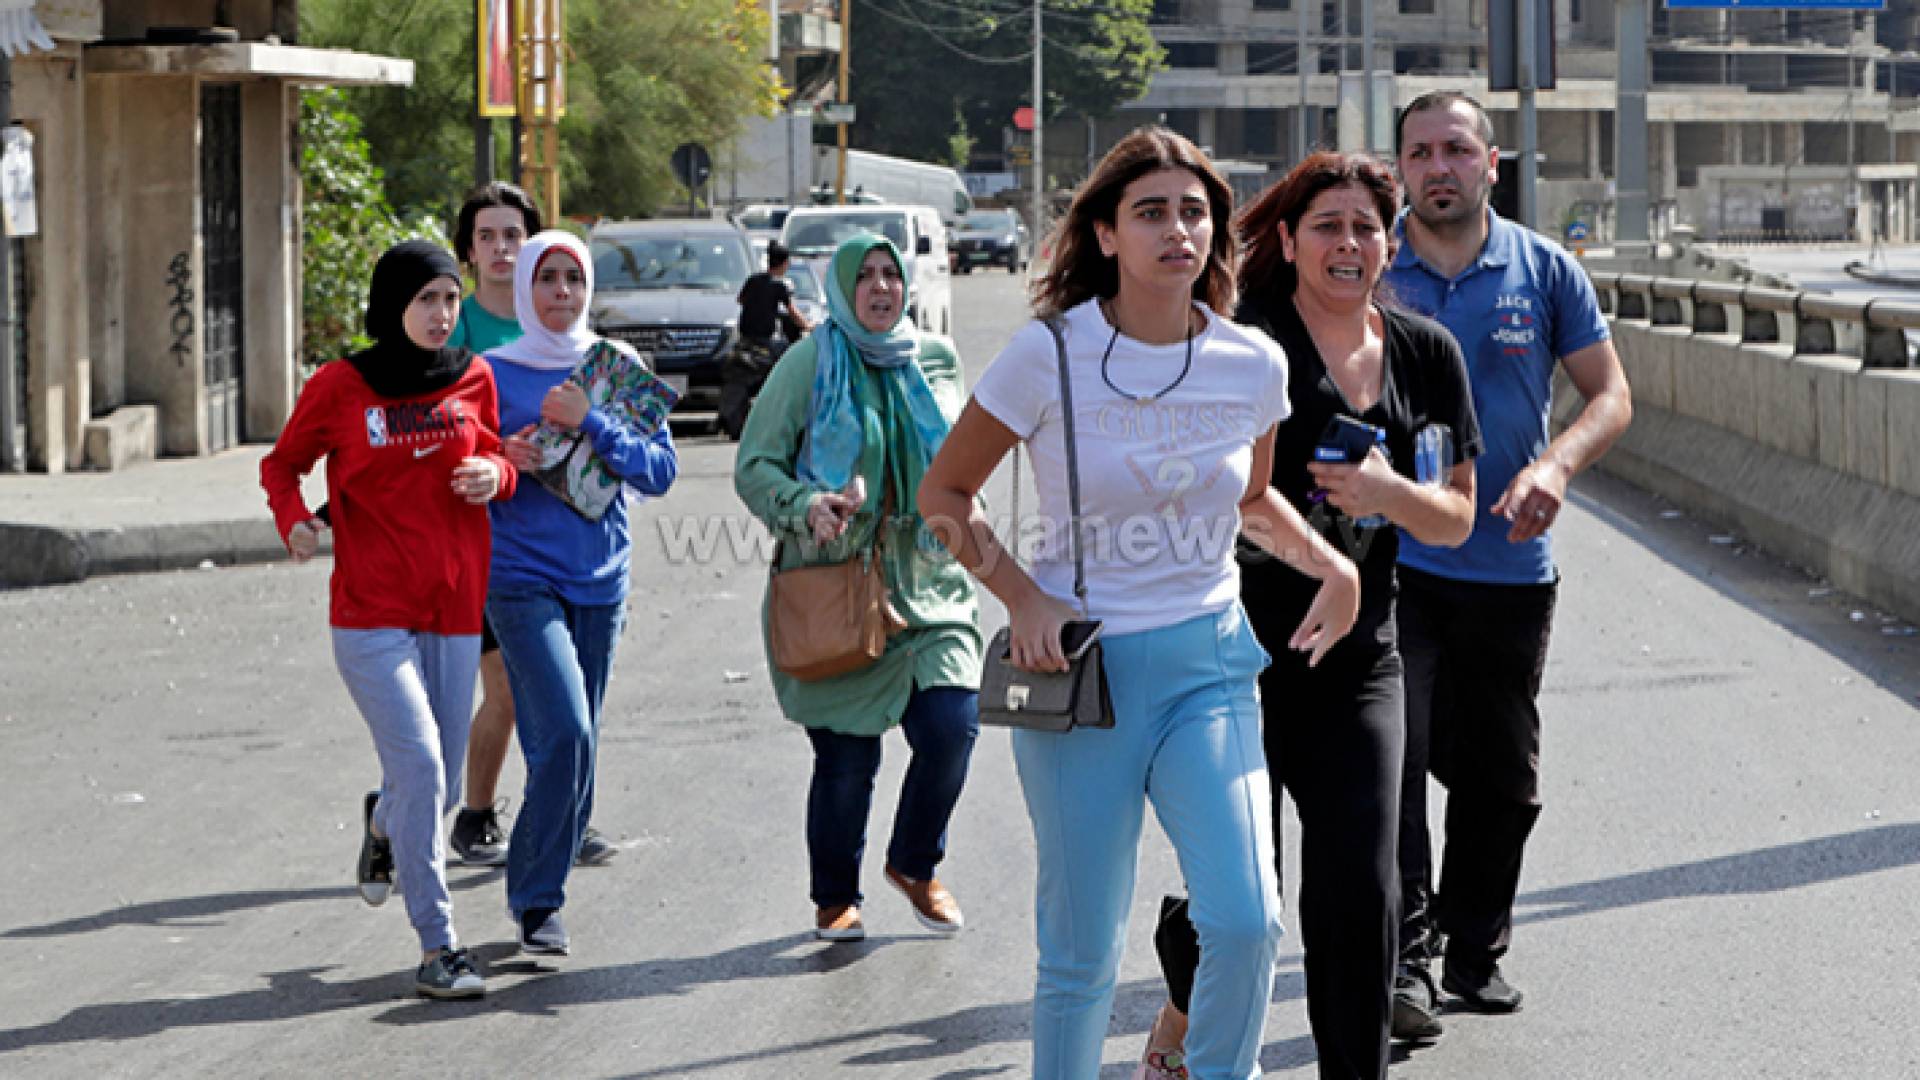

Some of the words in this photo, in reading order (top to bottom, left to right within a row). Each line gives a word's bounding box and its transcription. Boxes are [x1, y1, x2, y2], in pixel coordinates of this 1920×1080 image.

[1496, 294, 1532, 311] JACK
[1492, 327, 1536, 343] JONES
[1096, 402, 1244, 447] GUESS
